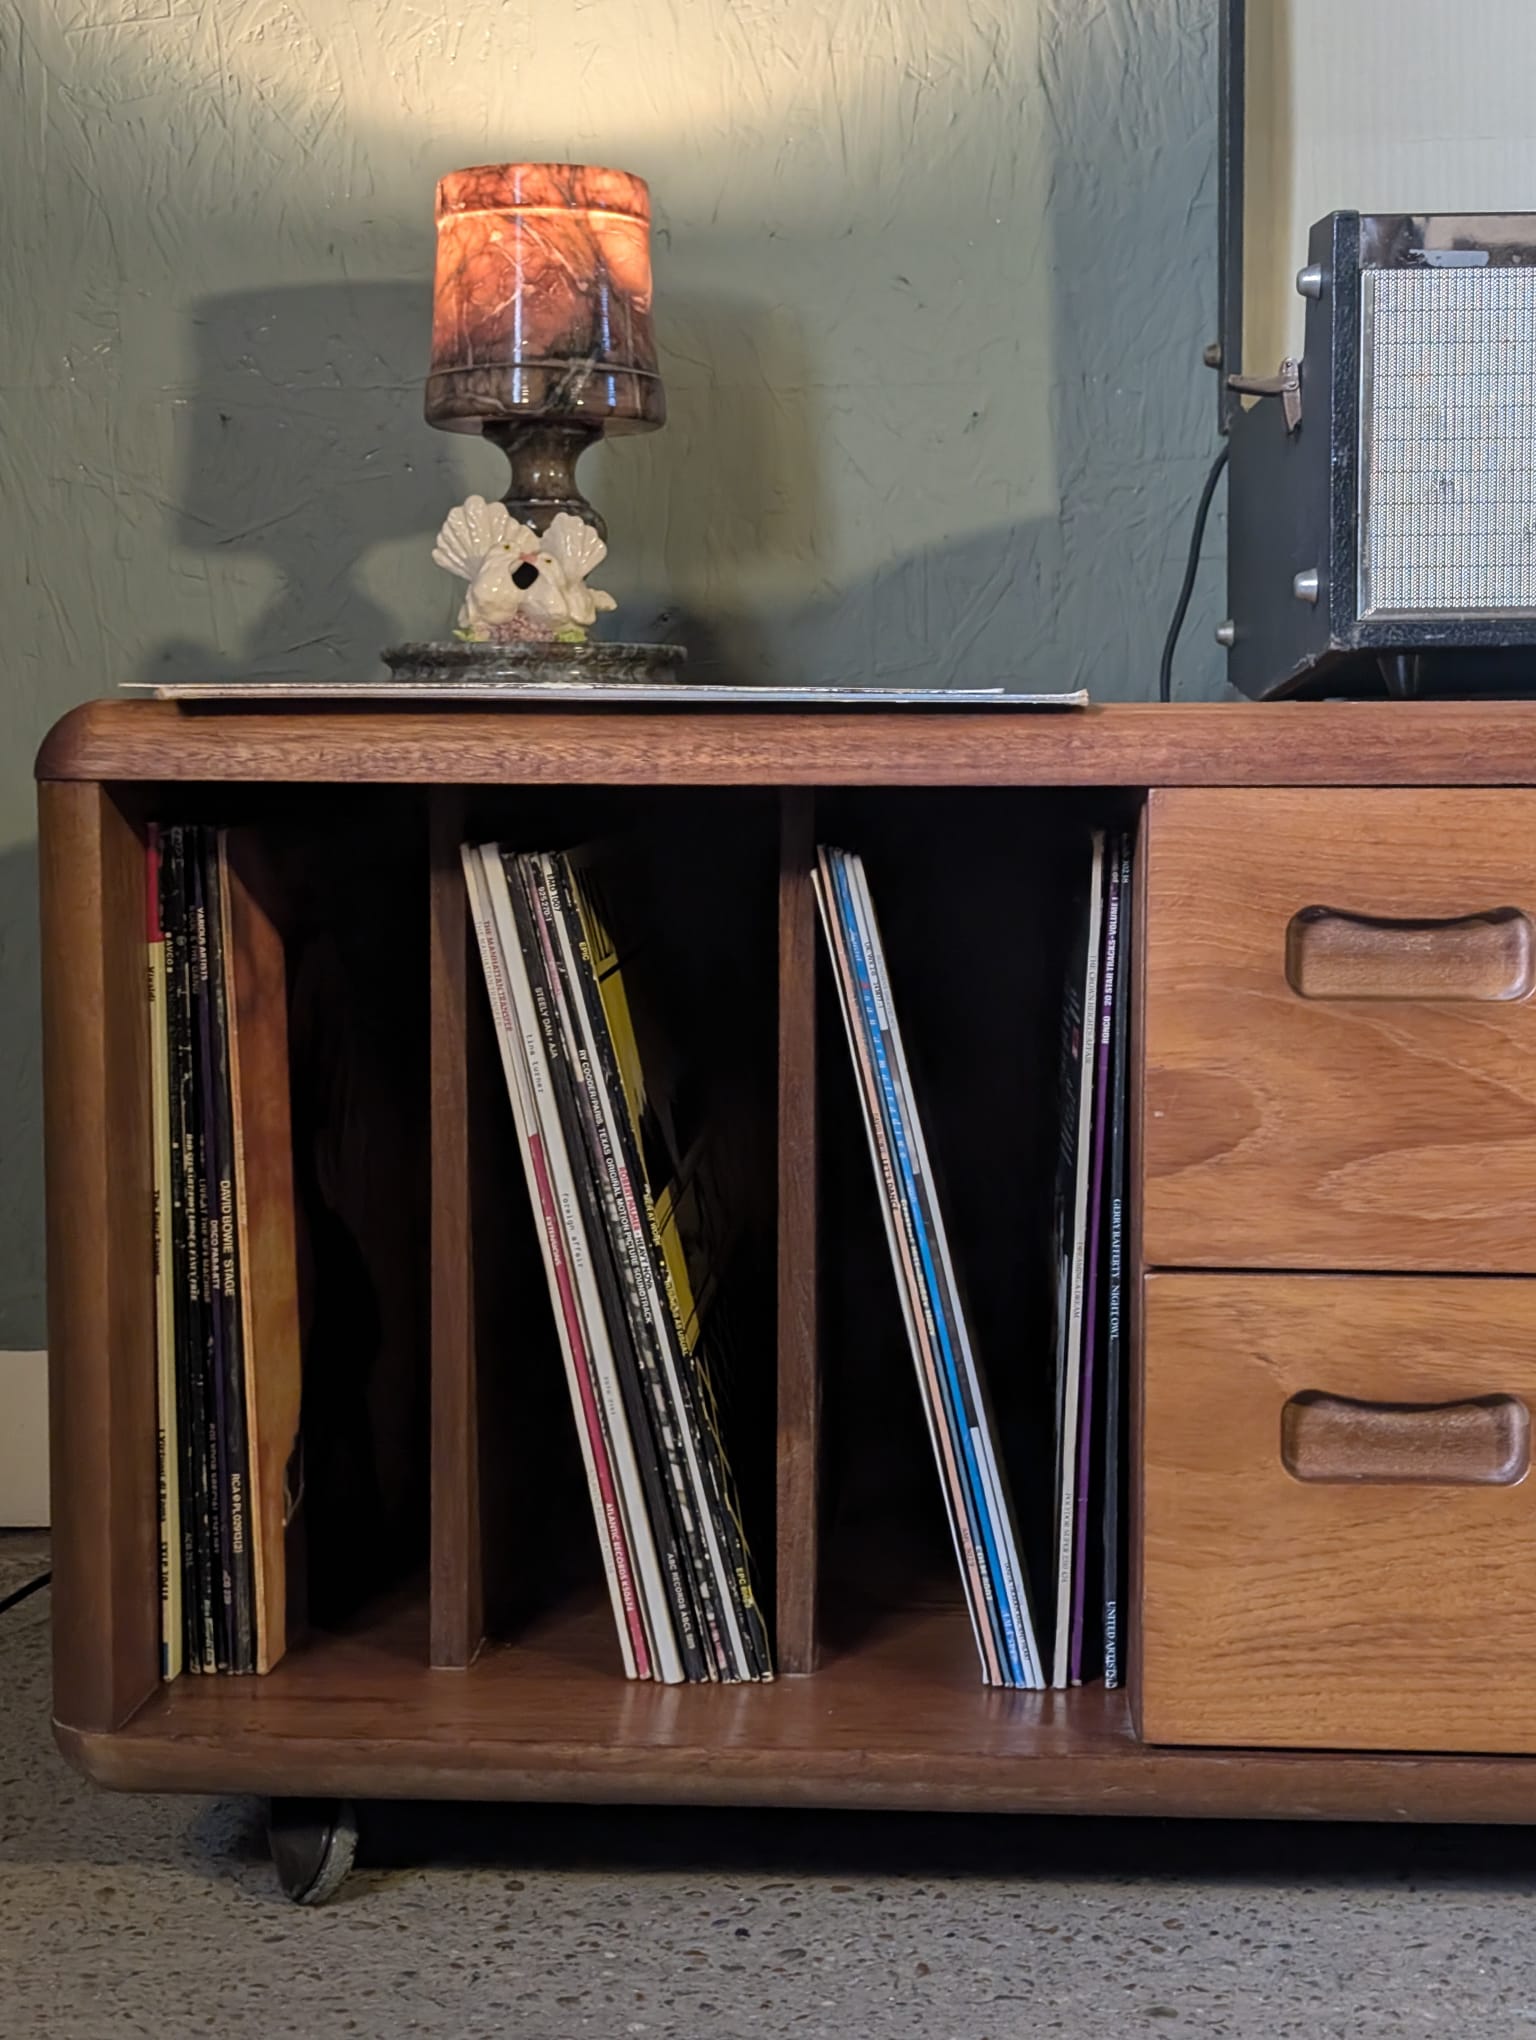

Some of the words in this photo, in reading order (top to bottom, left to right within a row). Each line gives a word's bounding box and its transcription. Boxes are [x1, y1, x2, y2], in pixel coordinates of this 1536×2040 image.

[550, 892, 562, 913] 1007
[195, 906, 206, 945] VARIOUS
[482, 919, 493, 937] THE
[165, 938, 174, 966] AVCO
[197, 945, 208, 981] ARTISTS
[485, 936, 504, 991] MANHATTAN
[577, 940, 590, 962] EPIC
[1088, 954, 1097, 969] THE
[1087, 971, 1096, 1001] CROWN
[1103, 974, 1114, 994] STAR
[496, 989, 513, 1033] TRANSFER
[533, 985, 549, 1018] STEELY
[1102, 994, 1112, 1006] 20
[540, 1017, 553, 1037] DAN
[1100, 1015, 1111, 1044] RONCO
[525, 1033, 536, 1056] tina
[546, 1041, 558, 1059] AJA
[577, 1048, 589, 1060] RY
[530, 1060, 544, 1093] turner
[597, 1126, 612, 1156] TEXAS
[604, 1156, 622, 1197] ORIGINAL
[617, 1165, 633, 1198] ROBERT
[880, 1157, 893, 1181] LET'S
[218, 1178, 231, 1213] DAVID
[885, 1180, 900, 1212] DANCE
[614, 1196, 630, 1232] MOTION
[625, 1196, 641, 1231] PALMER
[646, 1211, 655, 1223] AT
[1111, 1198, 1121, 1231] GERRY
[209, 1219, 219, 1246] DISCO
[220, 1214, 233, 1253] BOWIE
[544, 1215, 562, 1266] EXTENSIONS
[560, 1191, 576, 1231] foreign
[569, 1235, 584, 1269] affair
[648, 1221, 661, 1248] WORK
[622, 1230, 639, 1266] PICTURE
[634, 1235, 649, 1264] HEAVY
[1110, 1231, 1121, 1279] RAFFERTY
[221, 1257, 235, 1296] STAGE
[641, 1264, 655, 1290] NOVA
[631, 1266, 653, 1325] SOUNDTRACK
[1109, 1284, 1120, 1317] NIGHT
[672, 1317, 683, 1331] AS
[1109, 1317, 1119, 1341] OWL
[675, 1329, 689, 1357] USUAL
[230, 1472, 241, 1494] RCA
[604, 1501, 620, 1541] ATLANTIC
[611, 1540, 628, 1581] RECORDS
[666, 1551, 678, 1571] ABC
[670, 1570, 686, 1609] RECORDS
[1105, 1600, 1117, 1639] UNITED
